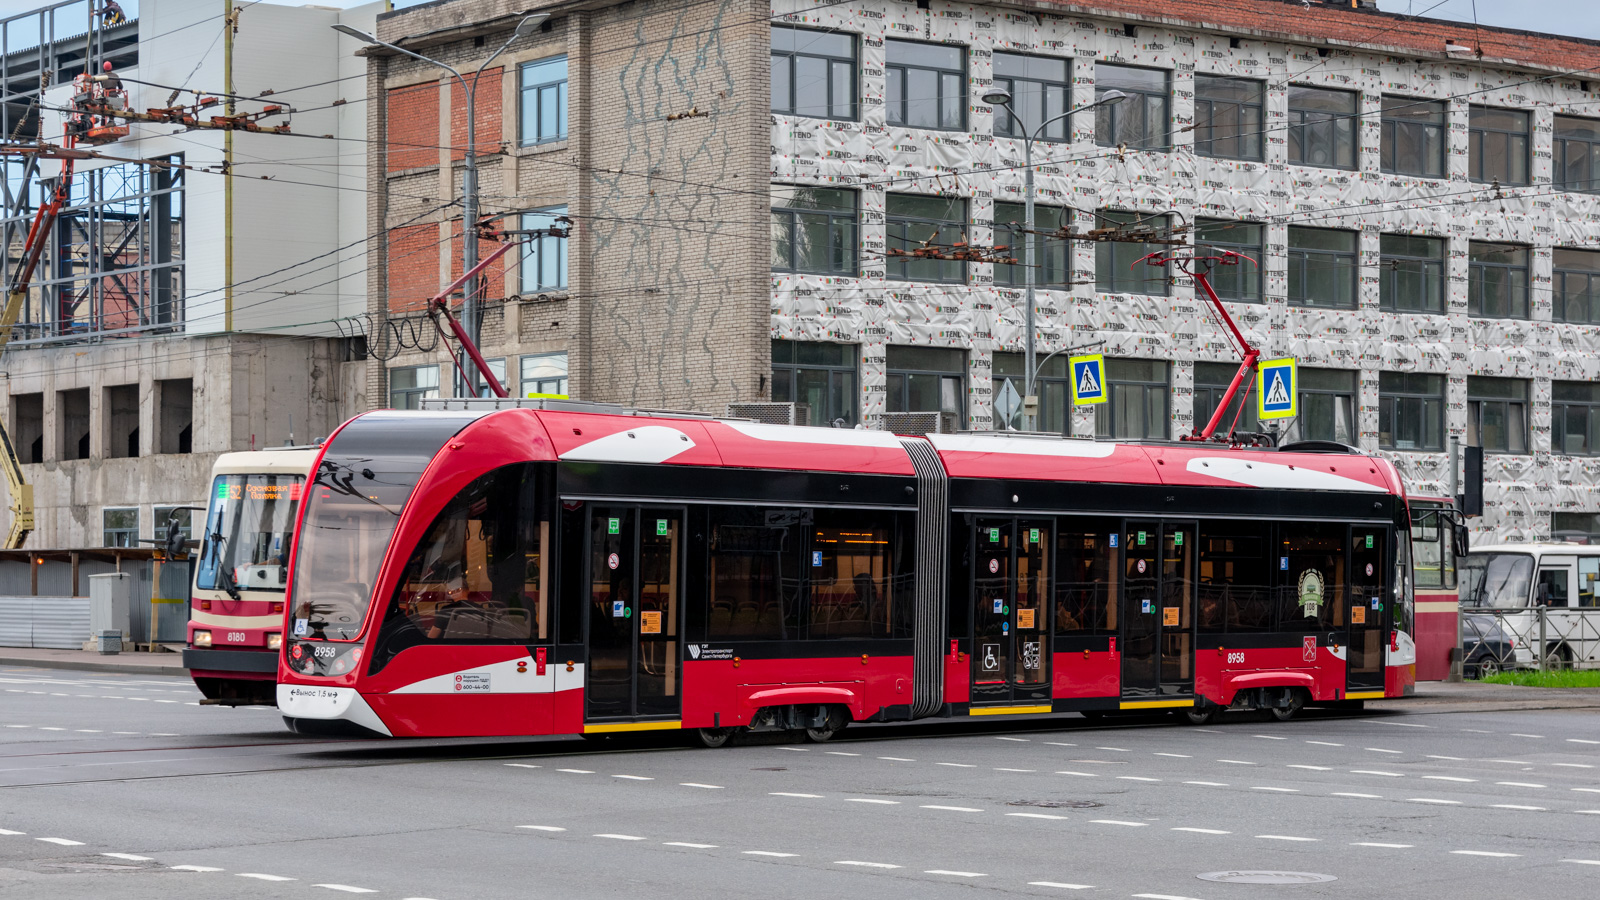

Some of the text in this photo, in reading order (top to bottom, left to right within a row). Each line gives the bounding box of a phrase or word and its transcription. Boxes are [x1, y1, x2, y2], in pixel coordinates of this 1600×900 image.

[897, 23, 914, 31] TEND
[864, 39, 881, 47] TEND
[230, 485, 241, 499] 52
[228, 632, 246, 642] 8180
[314, 646, 336, 657] 8958
[1228, 652, 1244, 663] 8958
